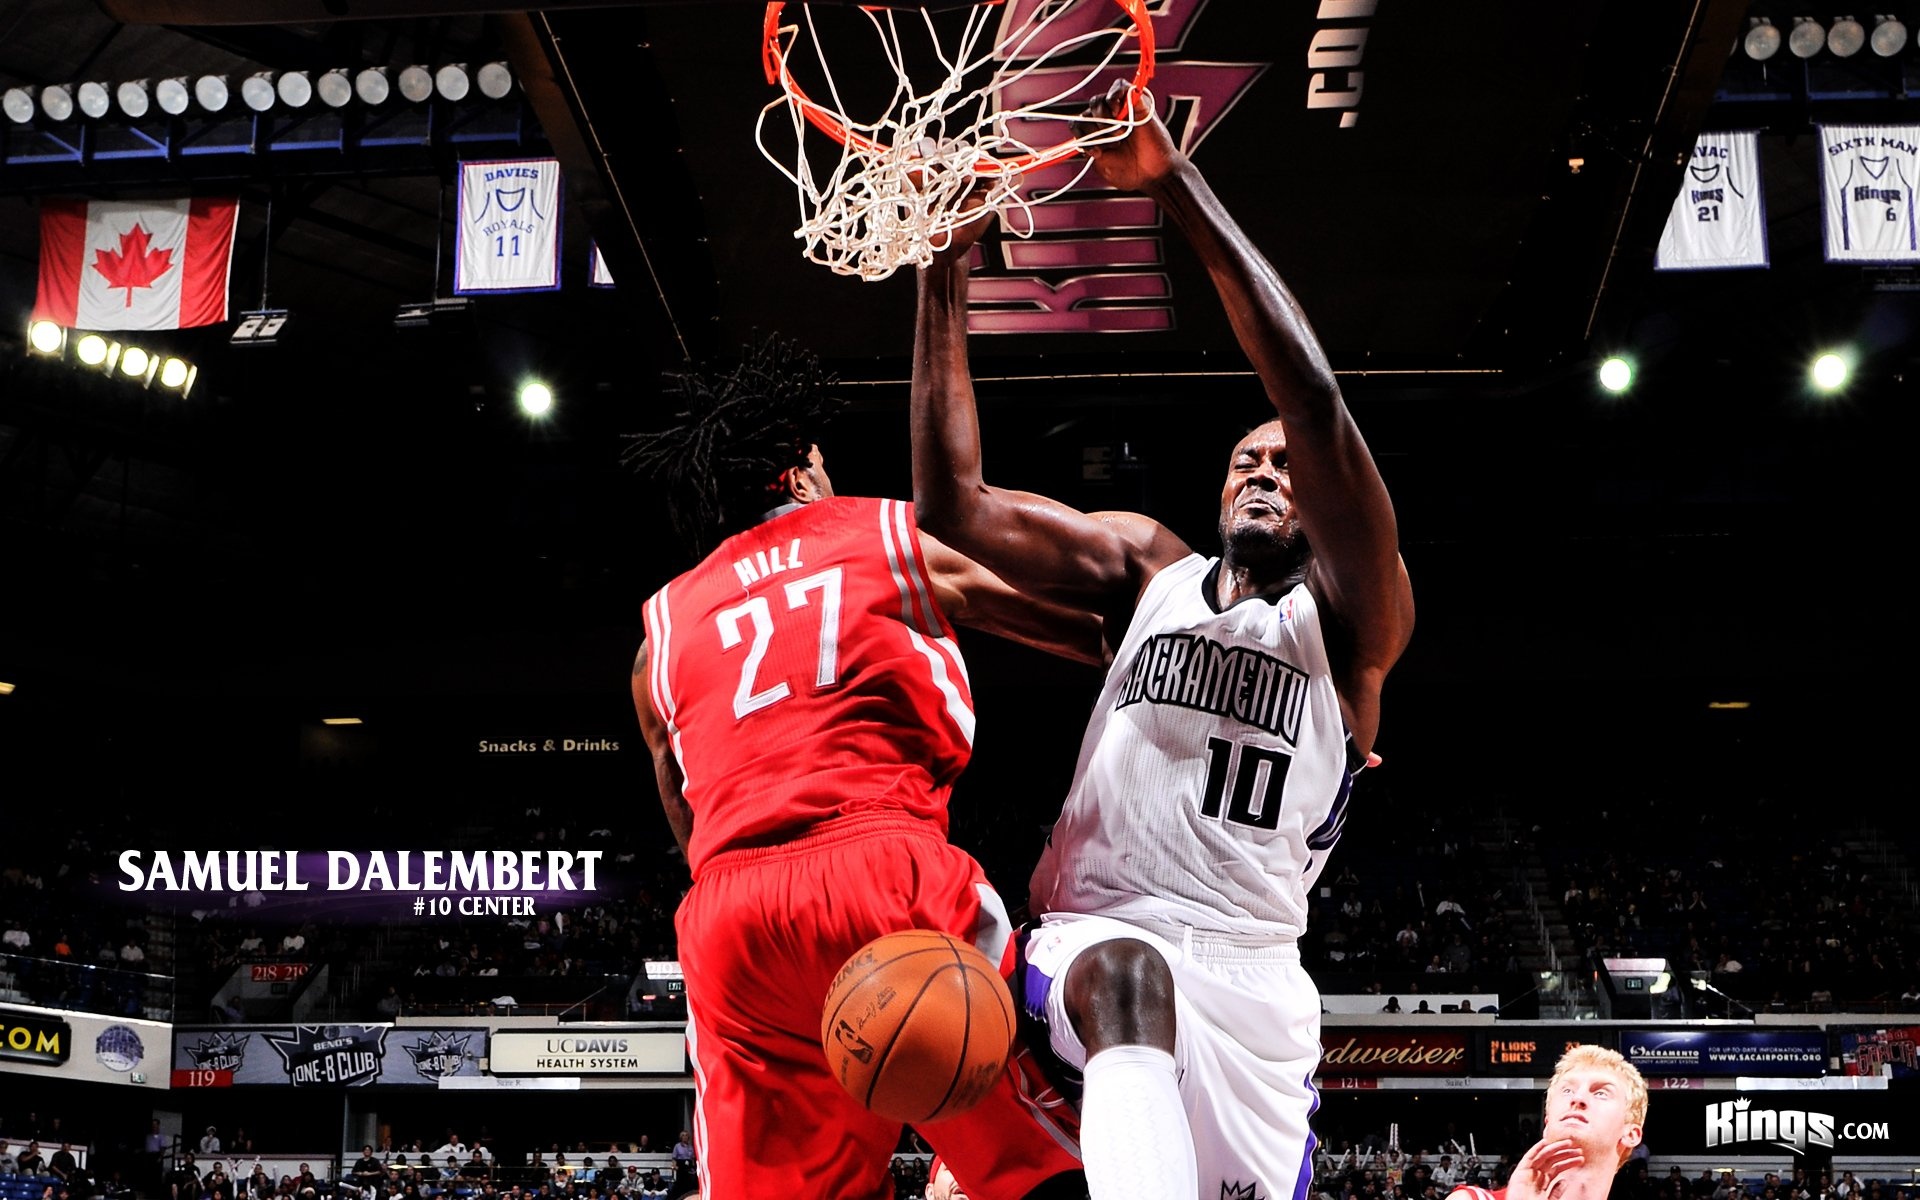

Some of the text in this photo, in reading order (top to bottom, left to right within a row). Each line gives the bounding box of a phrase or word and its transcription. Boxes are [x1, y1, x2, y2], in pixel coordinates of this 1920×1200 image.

[1828, 136, 1918, 157] SIXTH MAN
[485, 167, 539, 182] DAVIES
[1697, 205, 1719, 222] 21
[1886, 207, 1897, 221] 6
[482, 218, 535, 237] ROYALS
[496, 234, 520, 257] 11
[733, 538, 804, 588] HILL
[714, 566, 845, 722] 27
[478, 738, 620, 753] Snacks & Drinks
[1198, 734, 1295, 832] 10
[253, 965, 277, 981] 218
[0, 1024, 60, 1055] OM
[313, 1037, 353, 1051] BENO'S
[1501, 1041, 1537, 1052] LIONS
[1322, 1037, 1465, 1065] dweiser
[1501, 1052, 1532, 1063] BUCS
[1630, 1045, 1700, 1057] SACRAMENTO
[1709, 1053, 1822, 1062] WWW.SACAIRPORTS.ORG
[337, 1052, 375, 1081] CLUB
[536, 1058, 639, 1068] HEALTH SYSTEM
[188, 1070, 215, 1087] 119
[1340, 1077, 1359, 1089] 121
[1445, 1078, 1463, 1087] Suite
[1662, 1077, 1690, 1089] 122
[1797, 1079, 1828, 1087] Suite V
